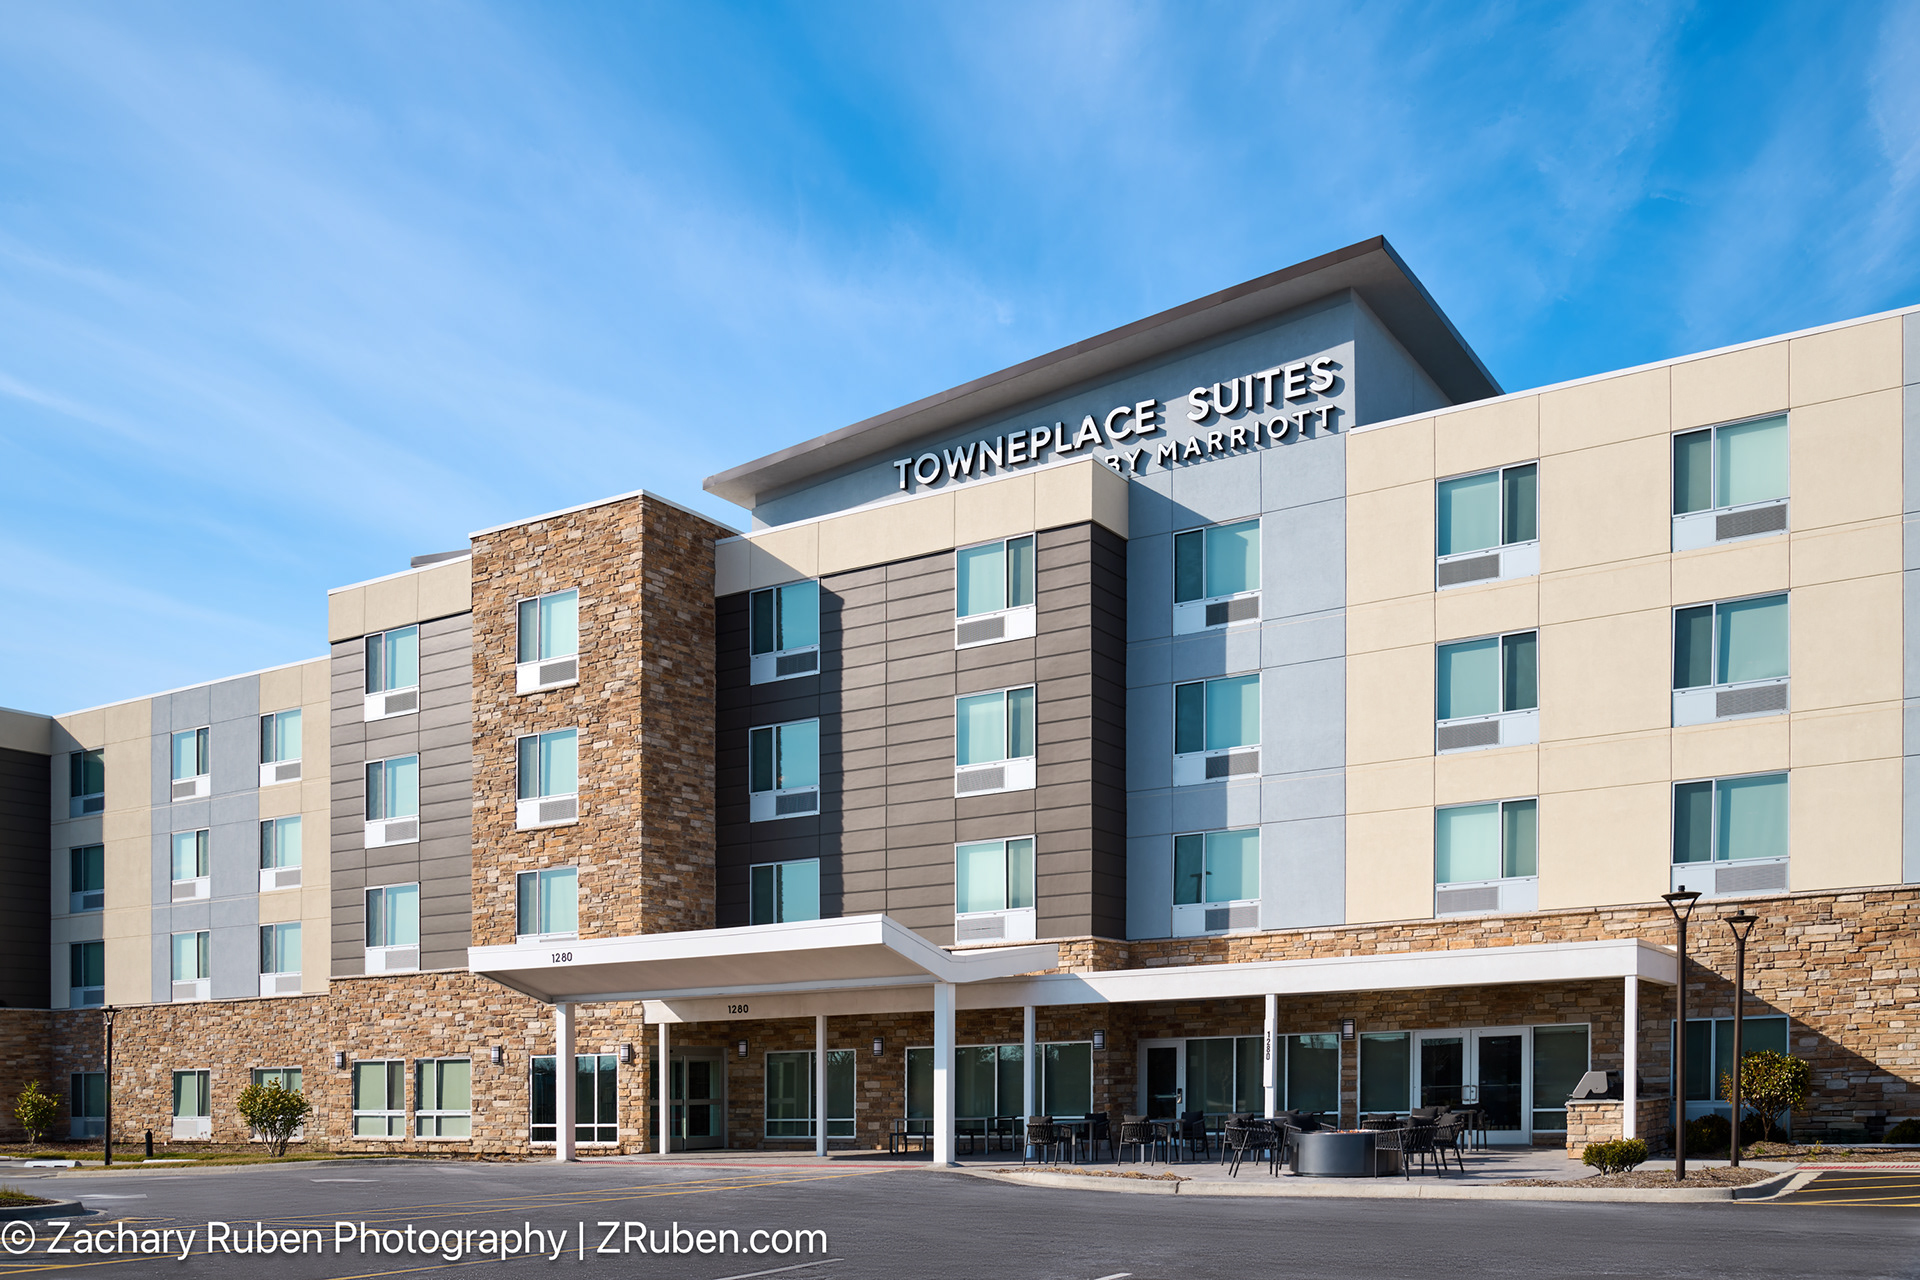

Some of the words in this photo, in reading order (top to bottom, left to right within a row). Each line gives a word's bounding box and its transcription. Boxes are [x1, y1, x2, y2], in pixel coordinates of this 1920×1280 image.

[893, 398, 1158, 489] TOWNEPLACE
[1187, 356, 1335, 421] SUITES
[1157, 404, 1336, 466] MARRIOTT
[551, 951, 573, 963] 1280
[727, 1004, 749, 1014] 1280
